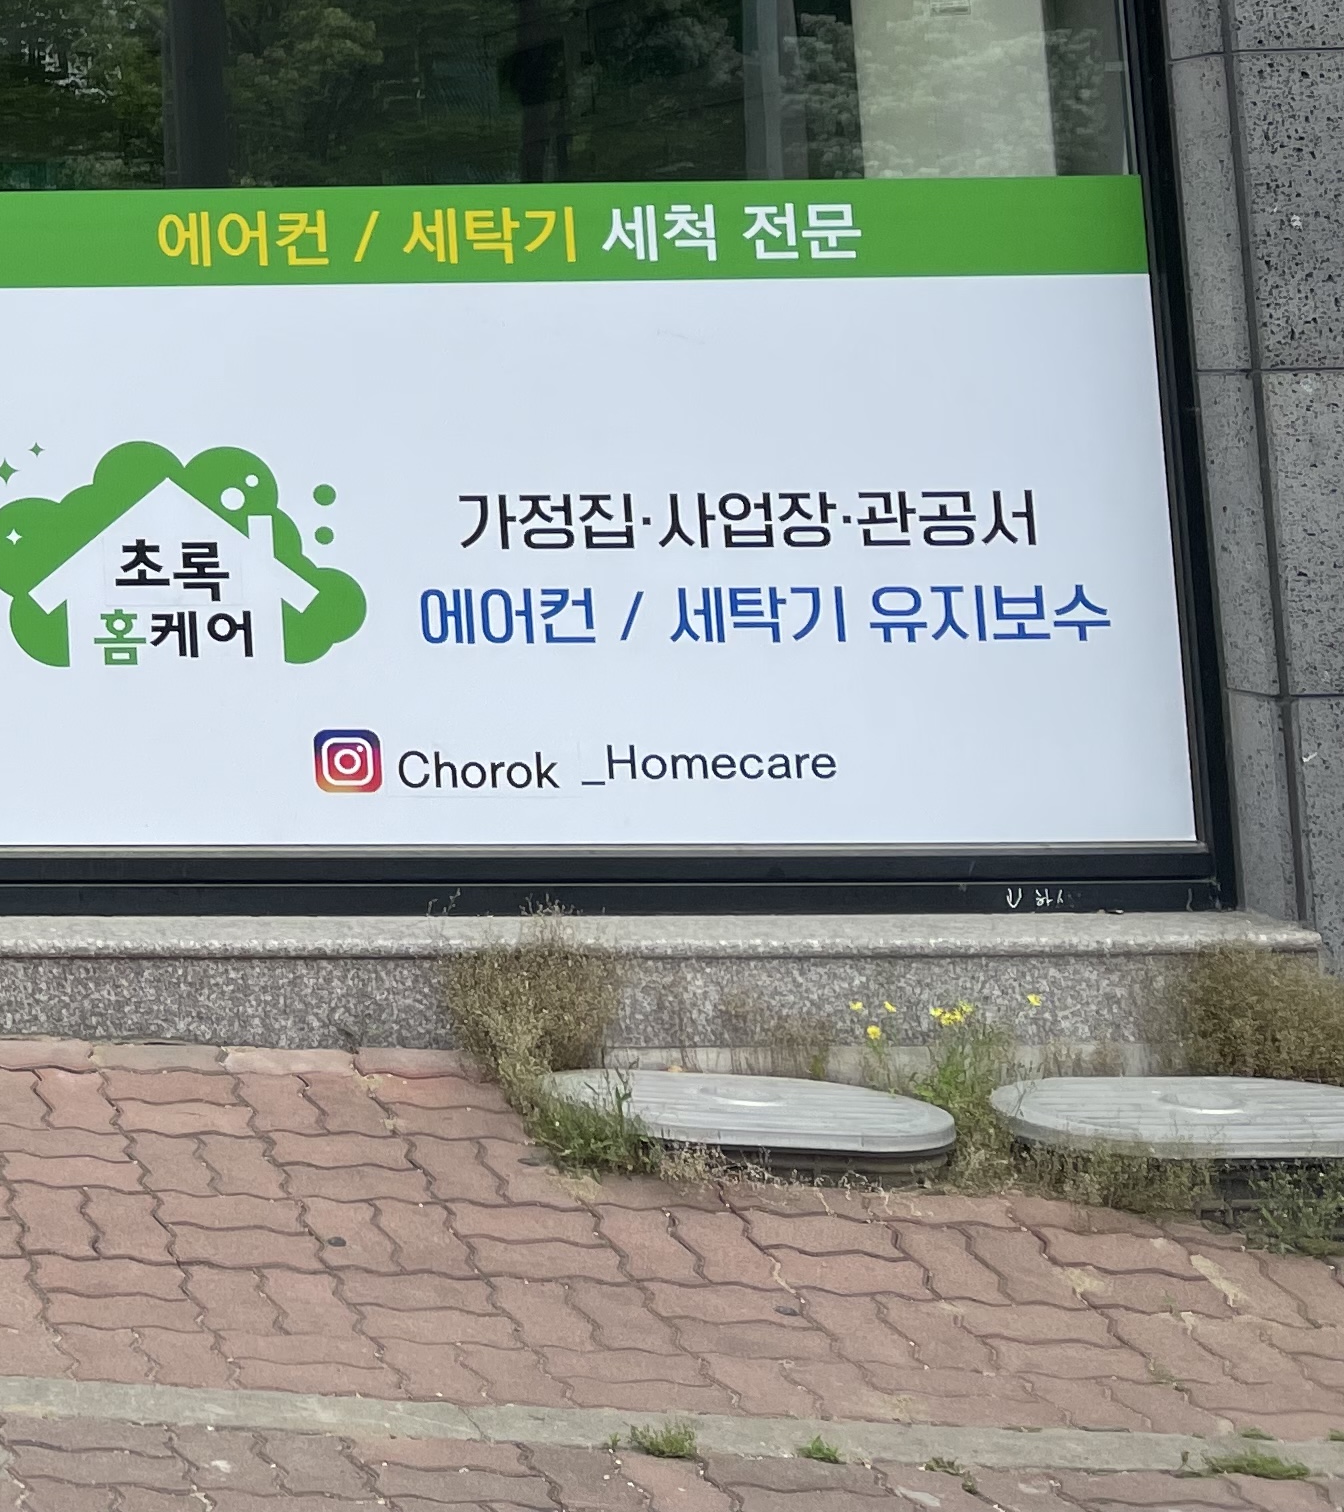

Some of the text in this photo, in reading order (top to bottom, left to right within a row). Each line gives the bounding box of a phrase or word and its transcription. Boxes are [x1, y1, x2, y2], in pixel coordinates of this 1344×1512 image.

[158, 203, 861, 266] 에어컨 / 세탁기 세척 전문
[115, 539, 229, 602] 초록
[94, 609, 253, 665] 홈케어
[421, 584, 1111, 644] 에어컨 / 세탁기 유지보수
[399, 751, 559, 788] Chorok
